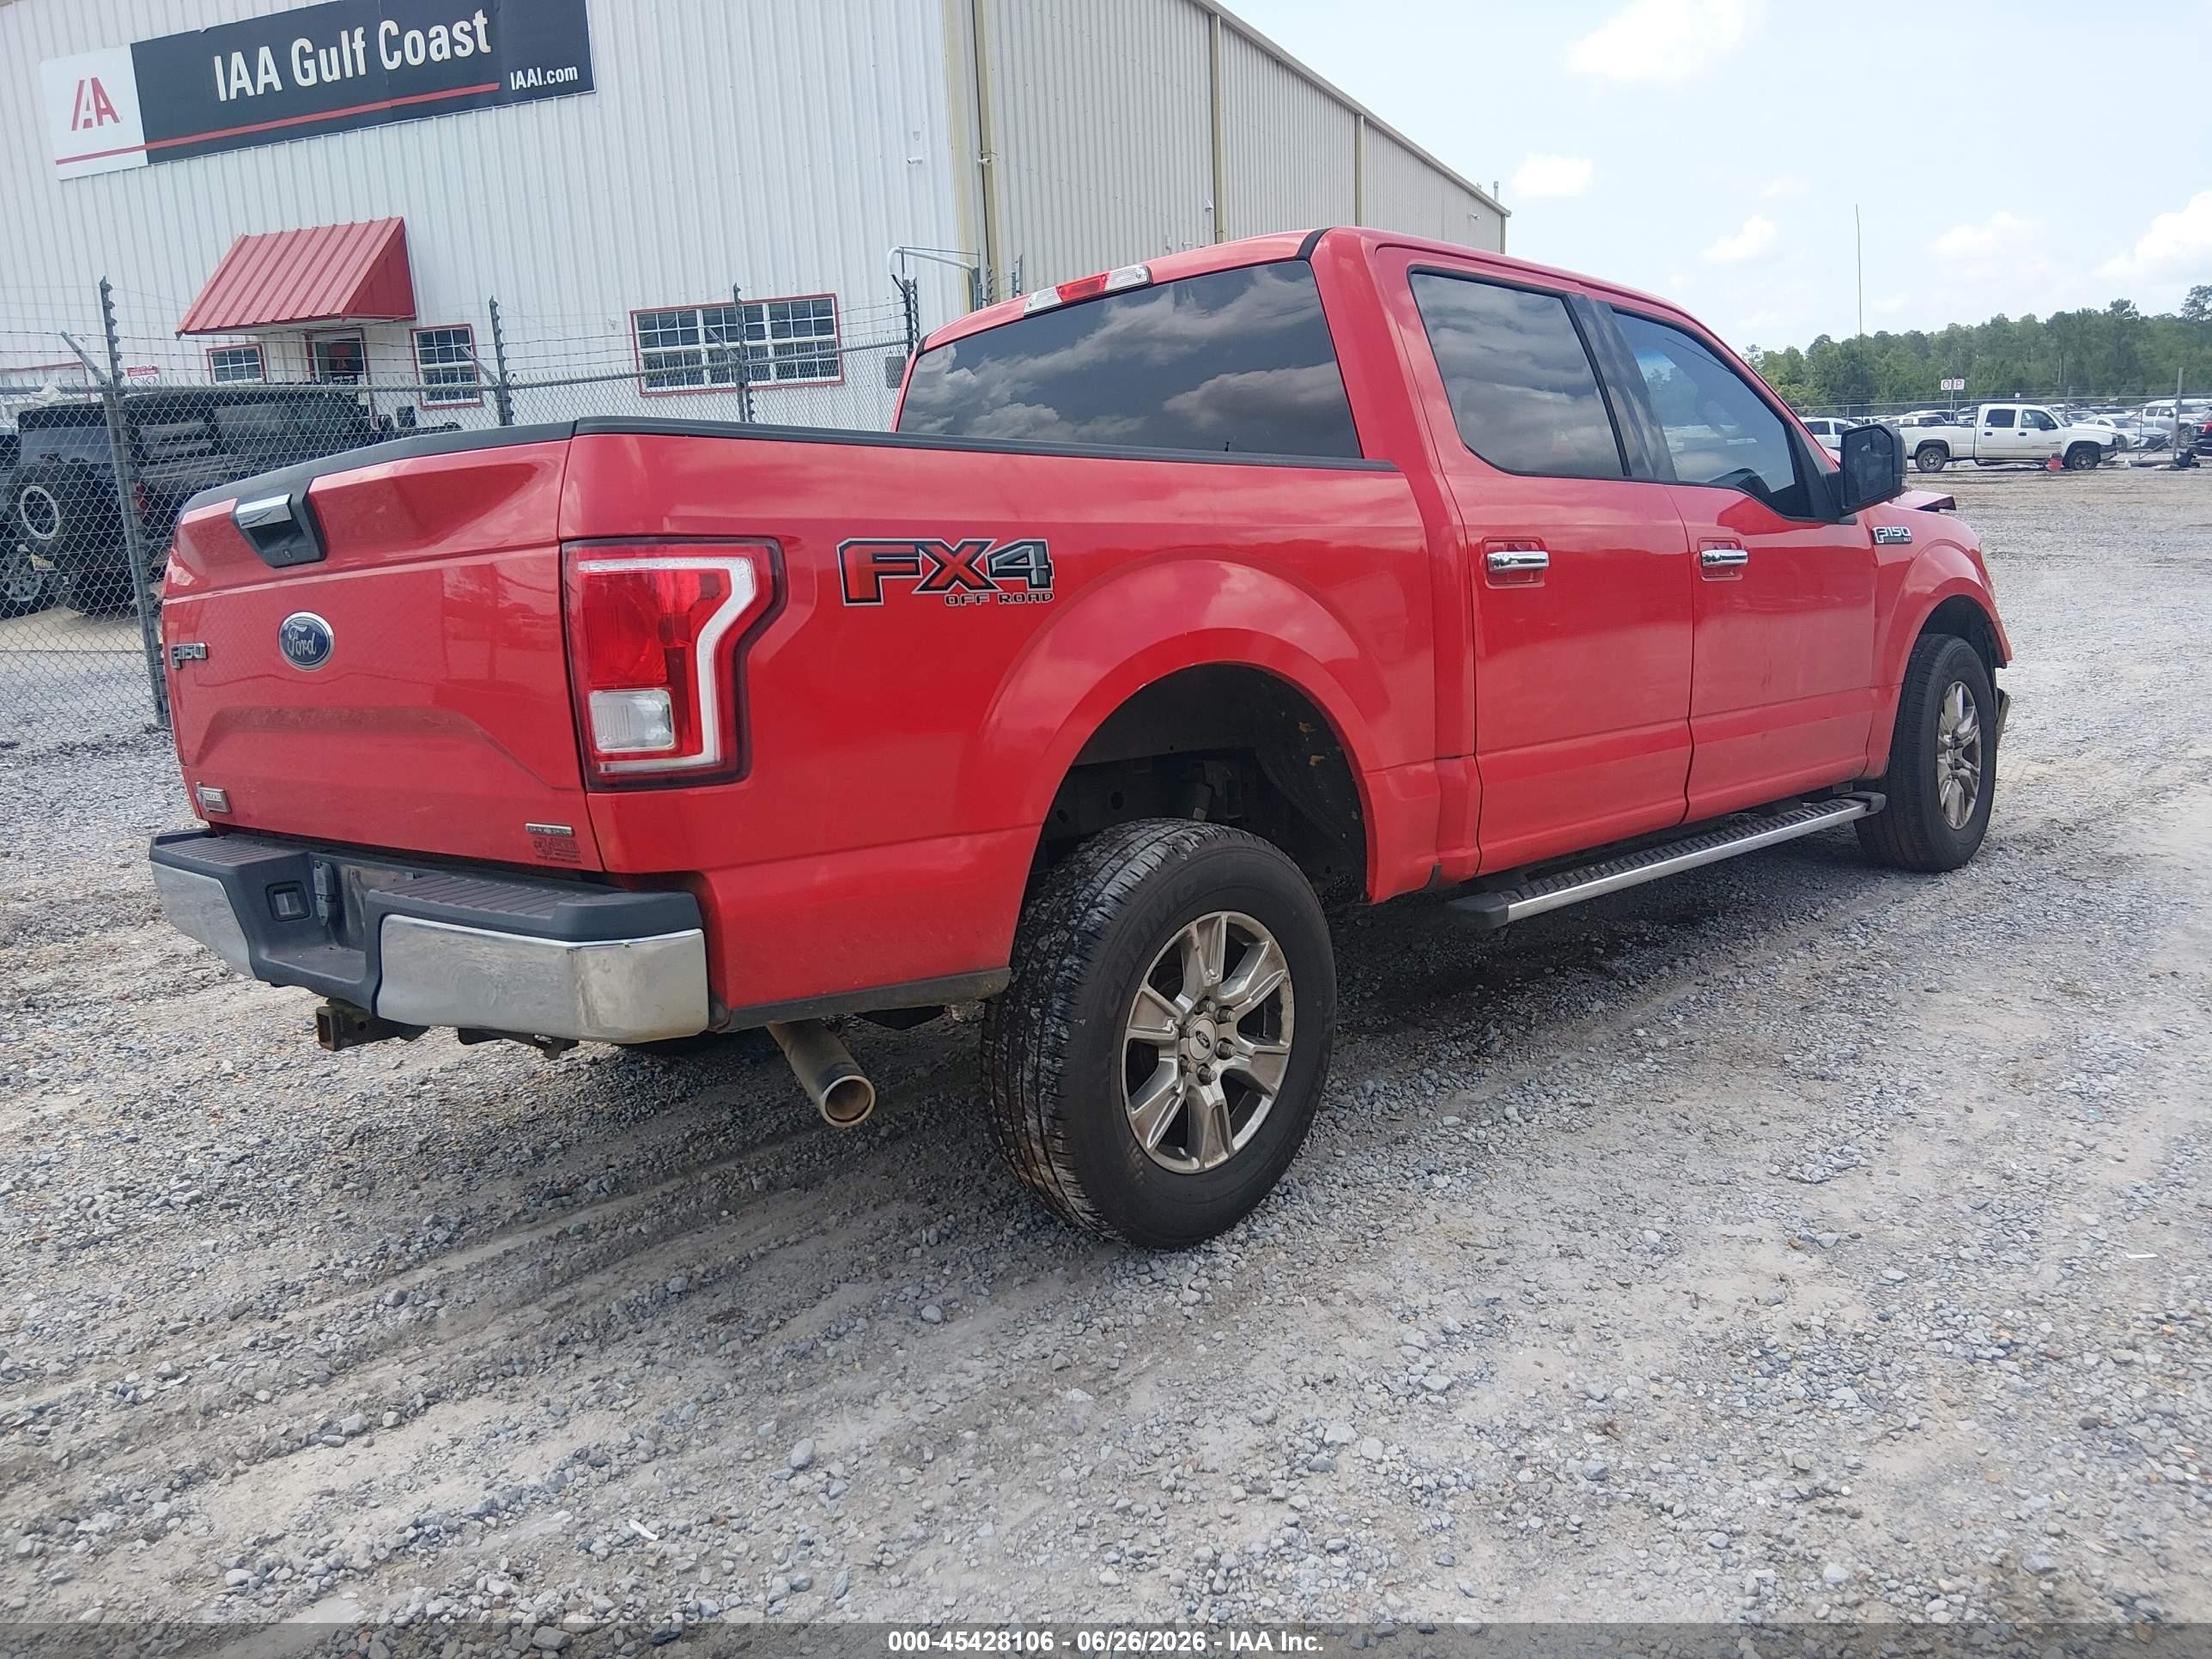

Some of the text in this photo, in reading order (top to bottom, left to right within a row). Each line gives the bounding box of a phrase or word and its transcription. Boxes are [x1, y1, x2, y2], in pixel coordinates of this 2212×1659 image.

[214, 9, 492, 101] IAA Gulf Coast
[510, 65, 579, 90] IAAI.com
[1954, 380, 1963, 389] P
[836, 538, 1054, 606] FX4
[945, 592, 1054, 606] OFF ROAD
[287, 624, 317, 658] Ford
